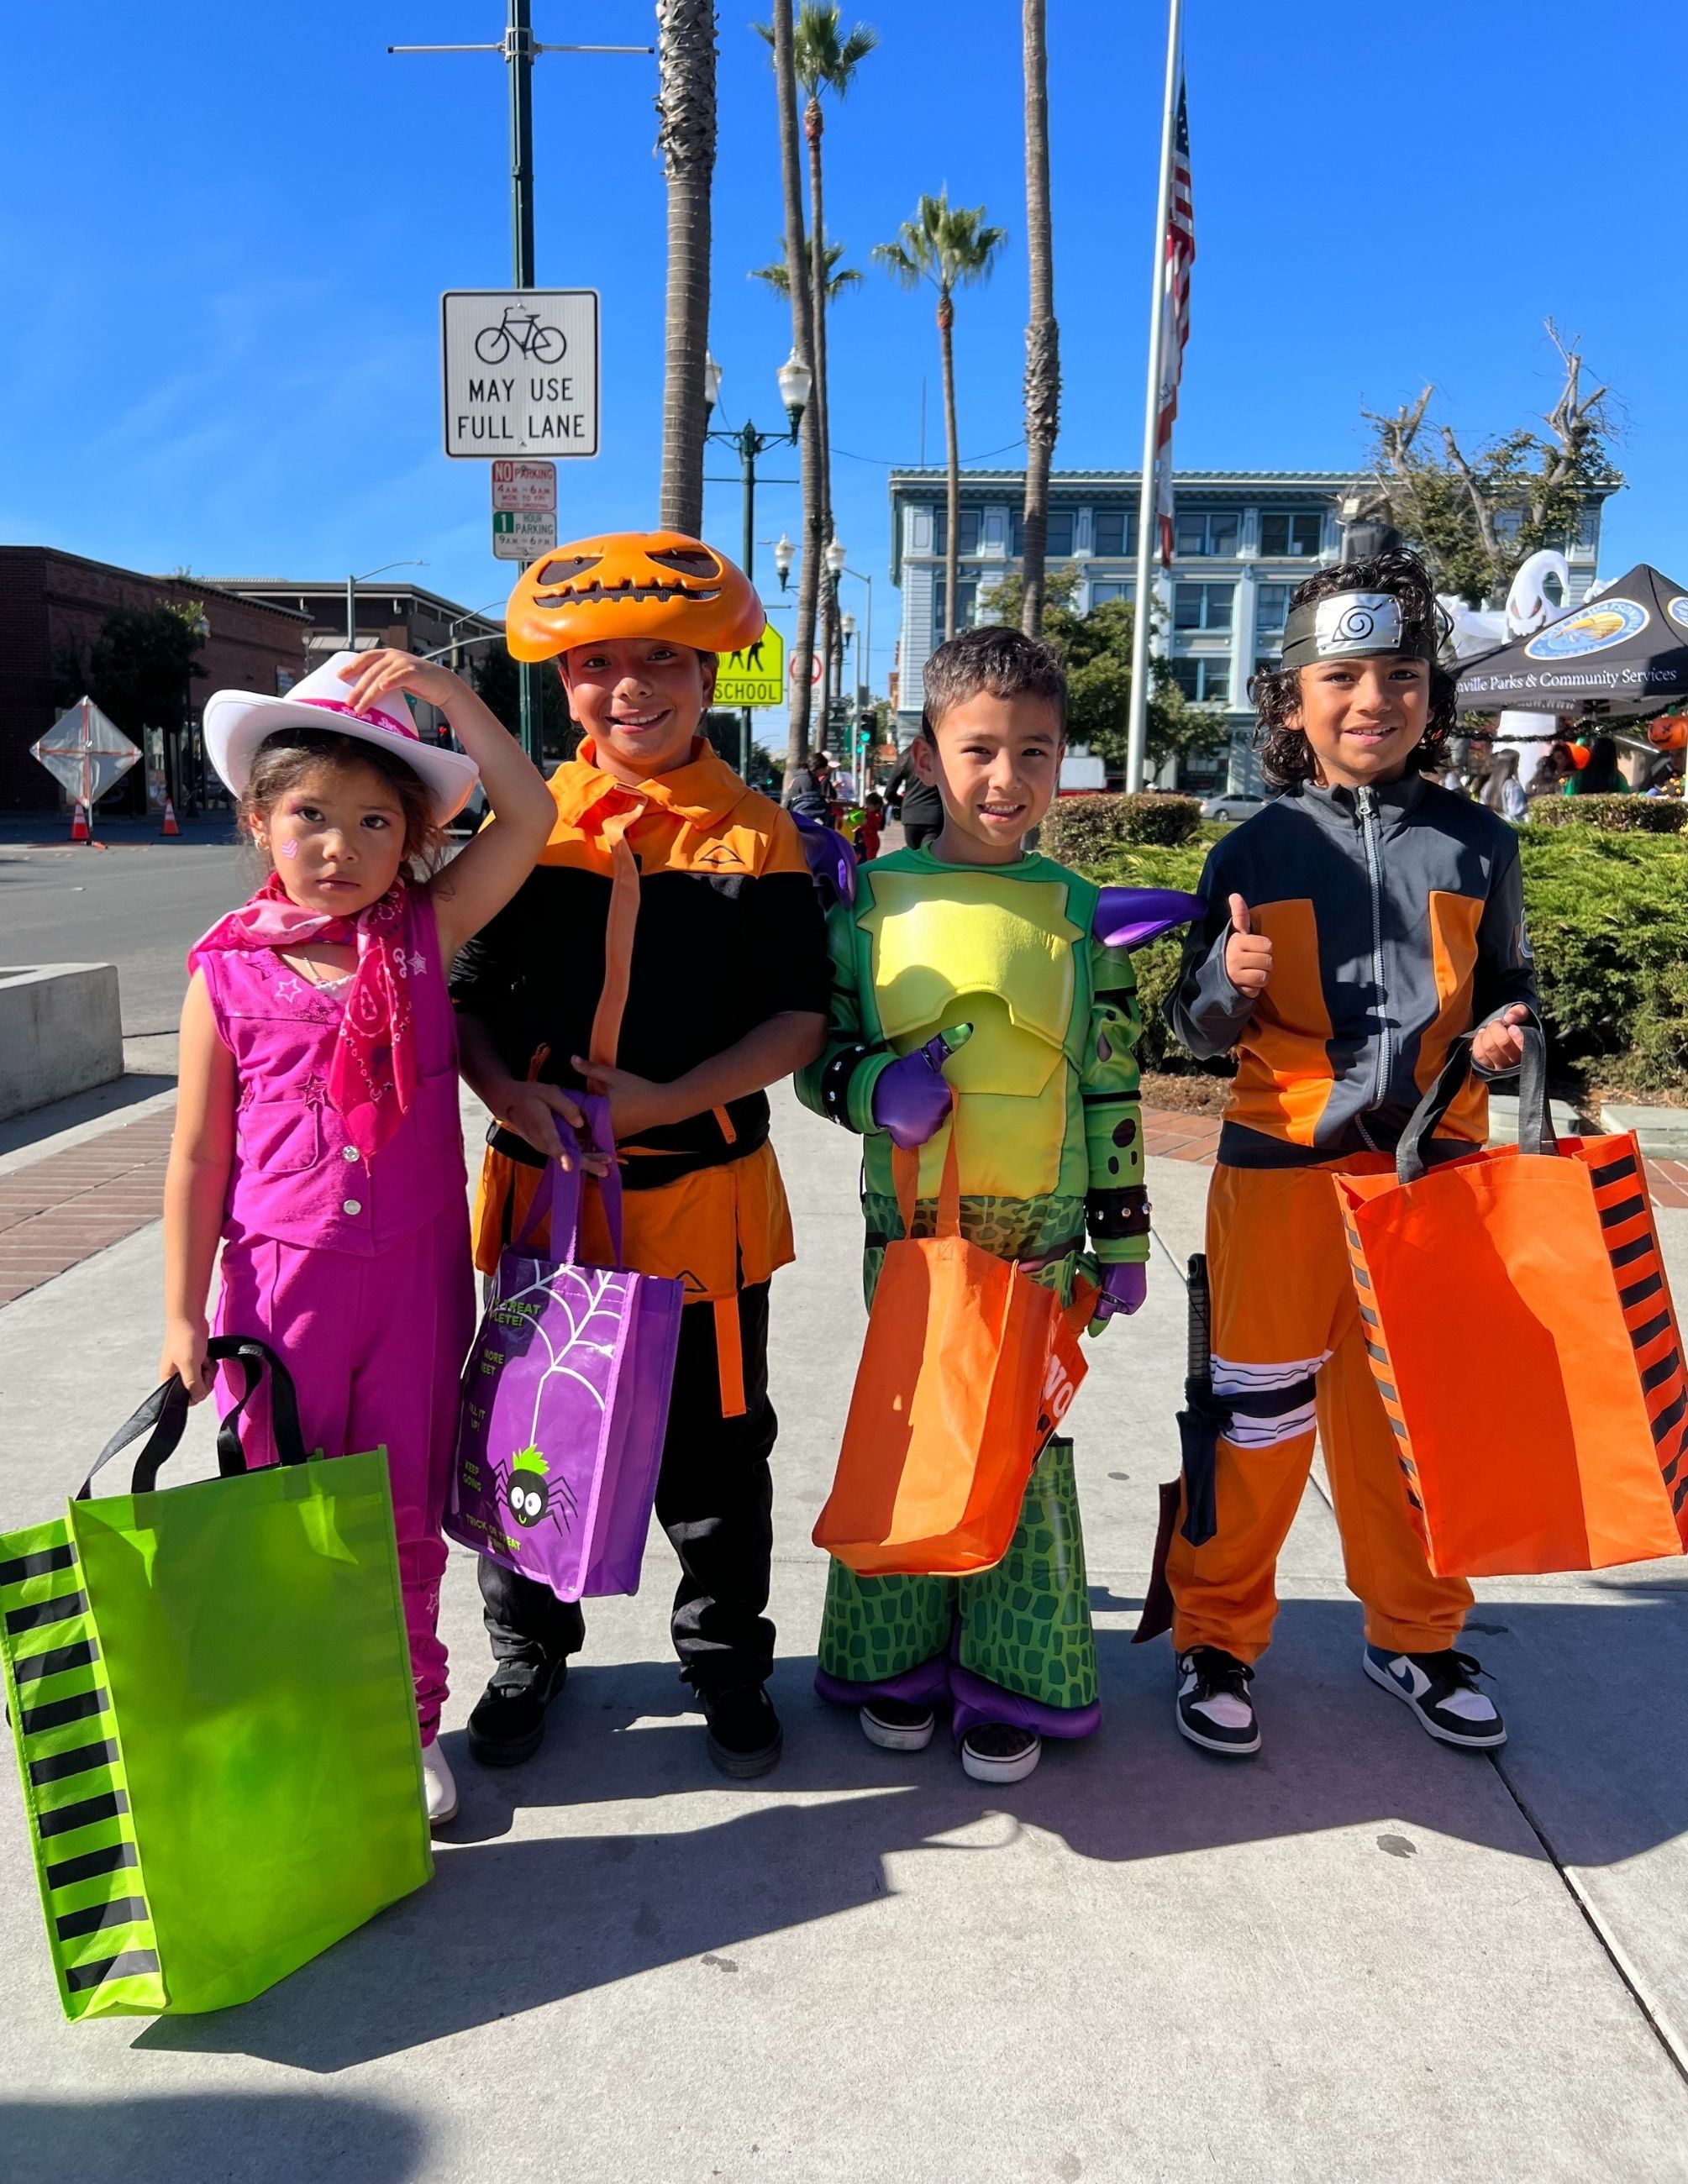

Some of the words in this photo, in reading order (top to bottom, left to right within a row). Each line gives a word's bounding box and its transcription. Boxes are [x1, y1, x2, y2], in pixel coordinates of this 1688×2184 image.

[469, 379, 515, 402] MAY
[530, 377, 573, 402] USE
[458, 415, 514, 438] FULL
[528, 414, 585, 438] LANE
[495, 462, 513, 482] NO
[514, 467, 553, 480] PARKING
[501, 513, 507, 533] 1
[523, 512, 543, 523] HOUR
[515, 522, 554, 536] PARKING
[1490, 674, 1524, 690] Parks
[1525, 673, 1538, 688] &
[1539, 669, 1620, 688] Community
[1622, 668, 1677, 684] Services
[713, 683, 778, 701] SCHOOL
[505, 1299, 541, 1316] TREAT
